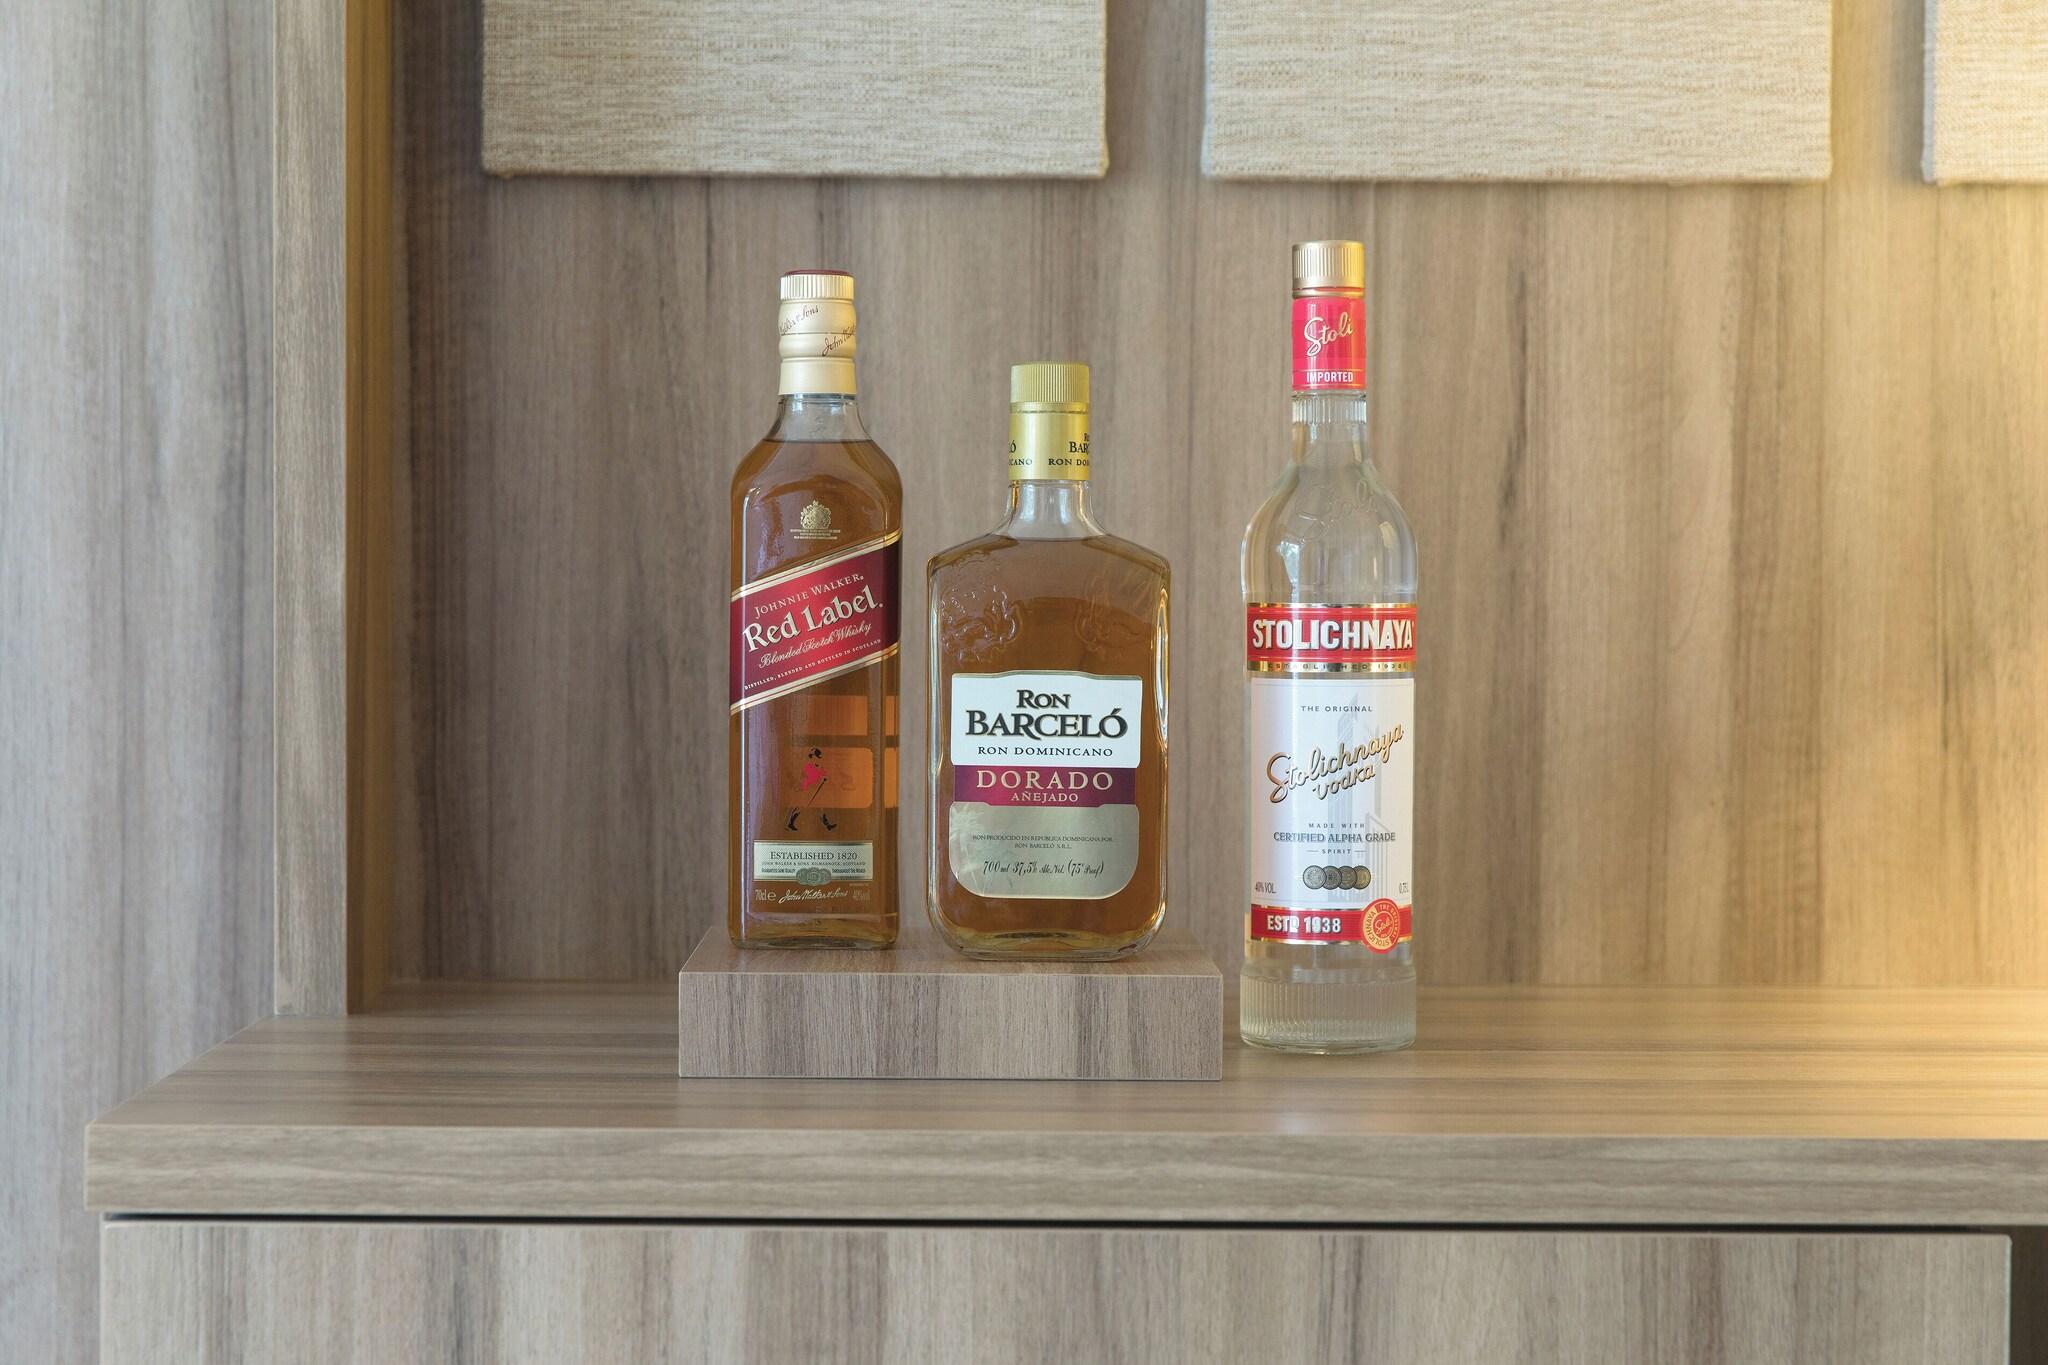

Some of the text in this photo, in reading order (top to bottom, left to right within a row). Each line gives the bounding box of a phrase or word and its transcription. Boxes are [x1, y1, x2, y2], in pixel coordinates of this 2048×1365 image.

[1303, 311, 1353, 357] Stoli
[822, 336, 843, 357] John
[1306, 371, 1354, 383] IMPORTED
[1069, 441, 1089, 455] BAR
[1048, 458, 1073, 466] RON
[755, 592, 810, 620] JOHNNIE
[743, 610, 801, 652] Red
[1252, 619, 1414, 650] STOLICHNAYA
[758, 619, 873, 669] Blended Scotch Whisky
[777, 666, 803, 679] BLENDED
[804, 662, 816, 670] AND
[816, 651, 843, 665] BOTTLED
[851, 639, 881, 653] SCOTLAND
[1016, 689, 1072, 709] RON
[965, 707, 1128, 740] BARCELÓ
[978, 746, 1113, 757] RON DOMINICANO
[1266, 722, 1404, 804] Stolichnaya
[976, 770, 1113, 791] DORADO
[1312, 763, 1376, 800] vodka
[1011, 790, 1079, 803] AÑEJADO
[1273, 831, 1396, 844] CERTIFIED ALPHA GRADE
[770, 851, 858, 860] ESTABLISHED 1820
[778, 889, 801, 904] John
[1266, 915, 1342, 934] ESTD 1938
[1366, 911, 1391, 947] STOLICHNAYA
